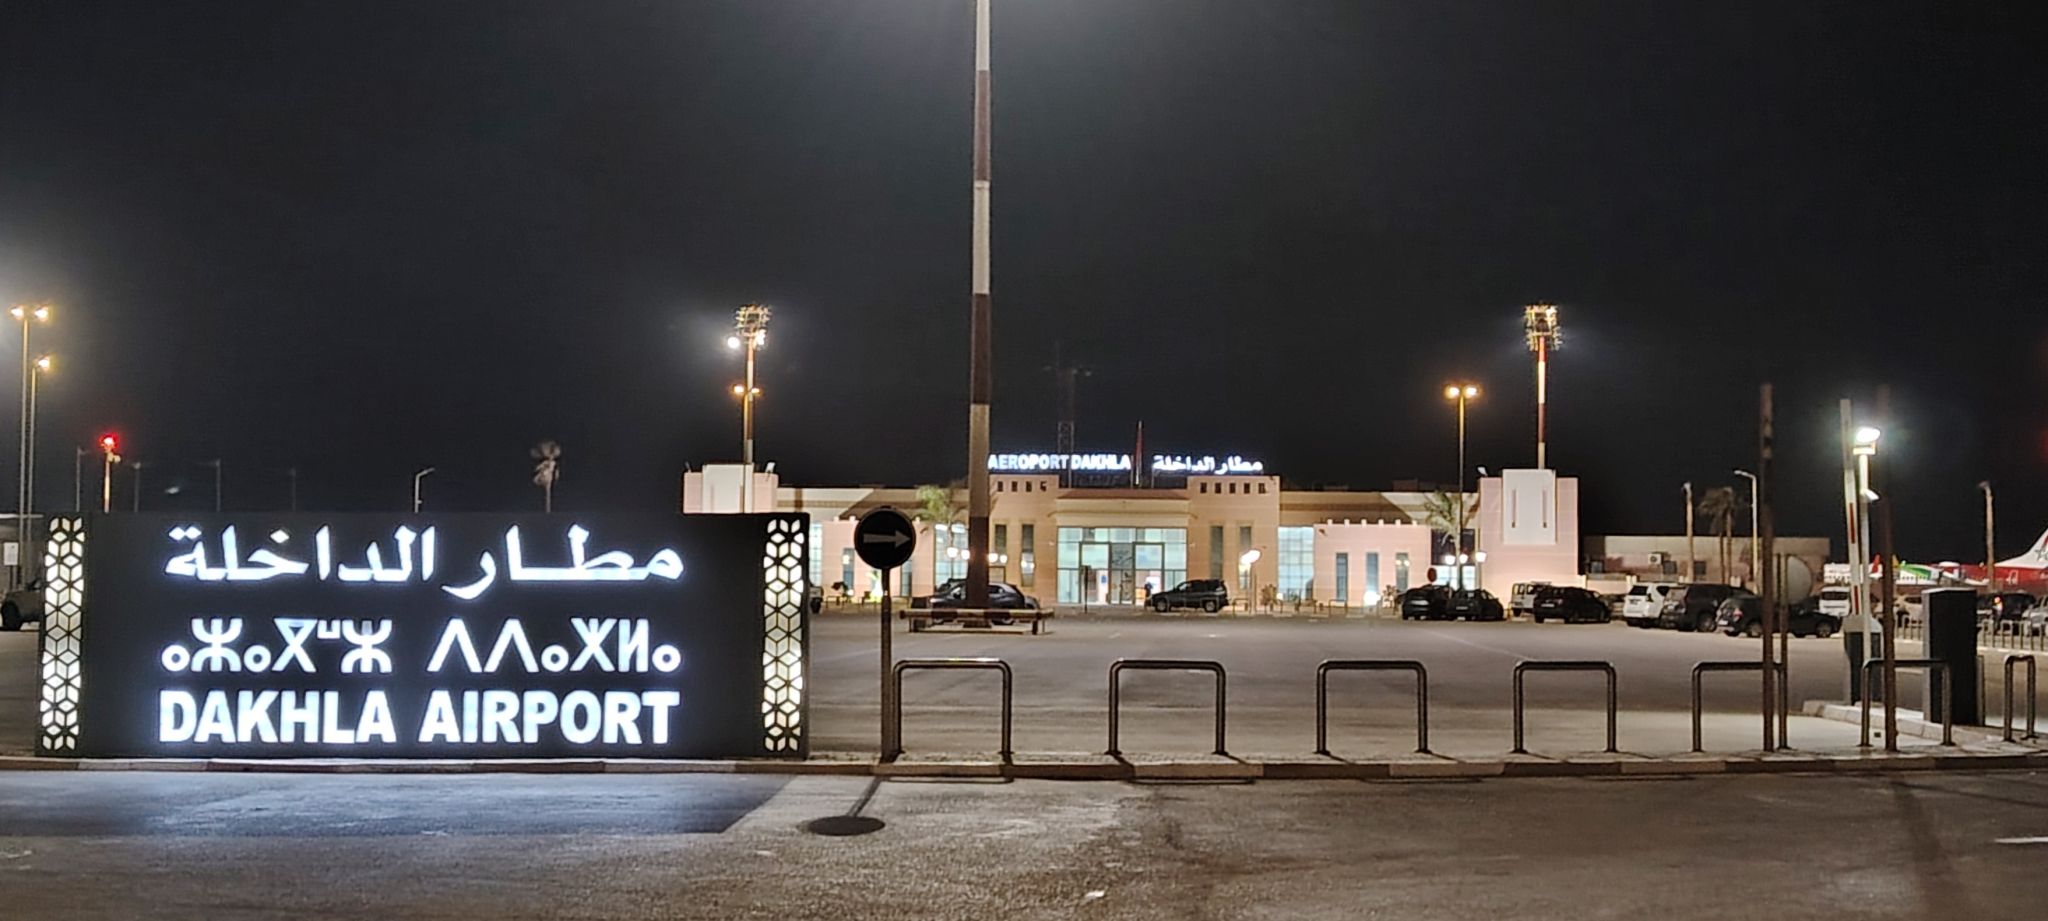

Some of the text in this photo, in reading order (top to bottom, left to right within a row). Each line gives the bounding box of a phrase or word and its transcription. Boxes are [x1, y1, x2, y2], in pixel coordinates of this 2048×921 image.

[987, 453, 1132, 471] AEROPORT DAKHLA
[1152, 454, 1264, 475] مطار الداخلة
[165, 524, 685, 600] مطار الداخلة
[158, 690, 681, 744] DAKHLA AIRPORT
